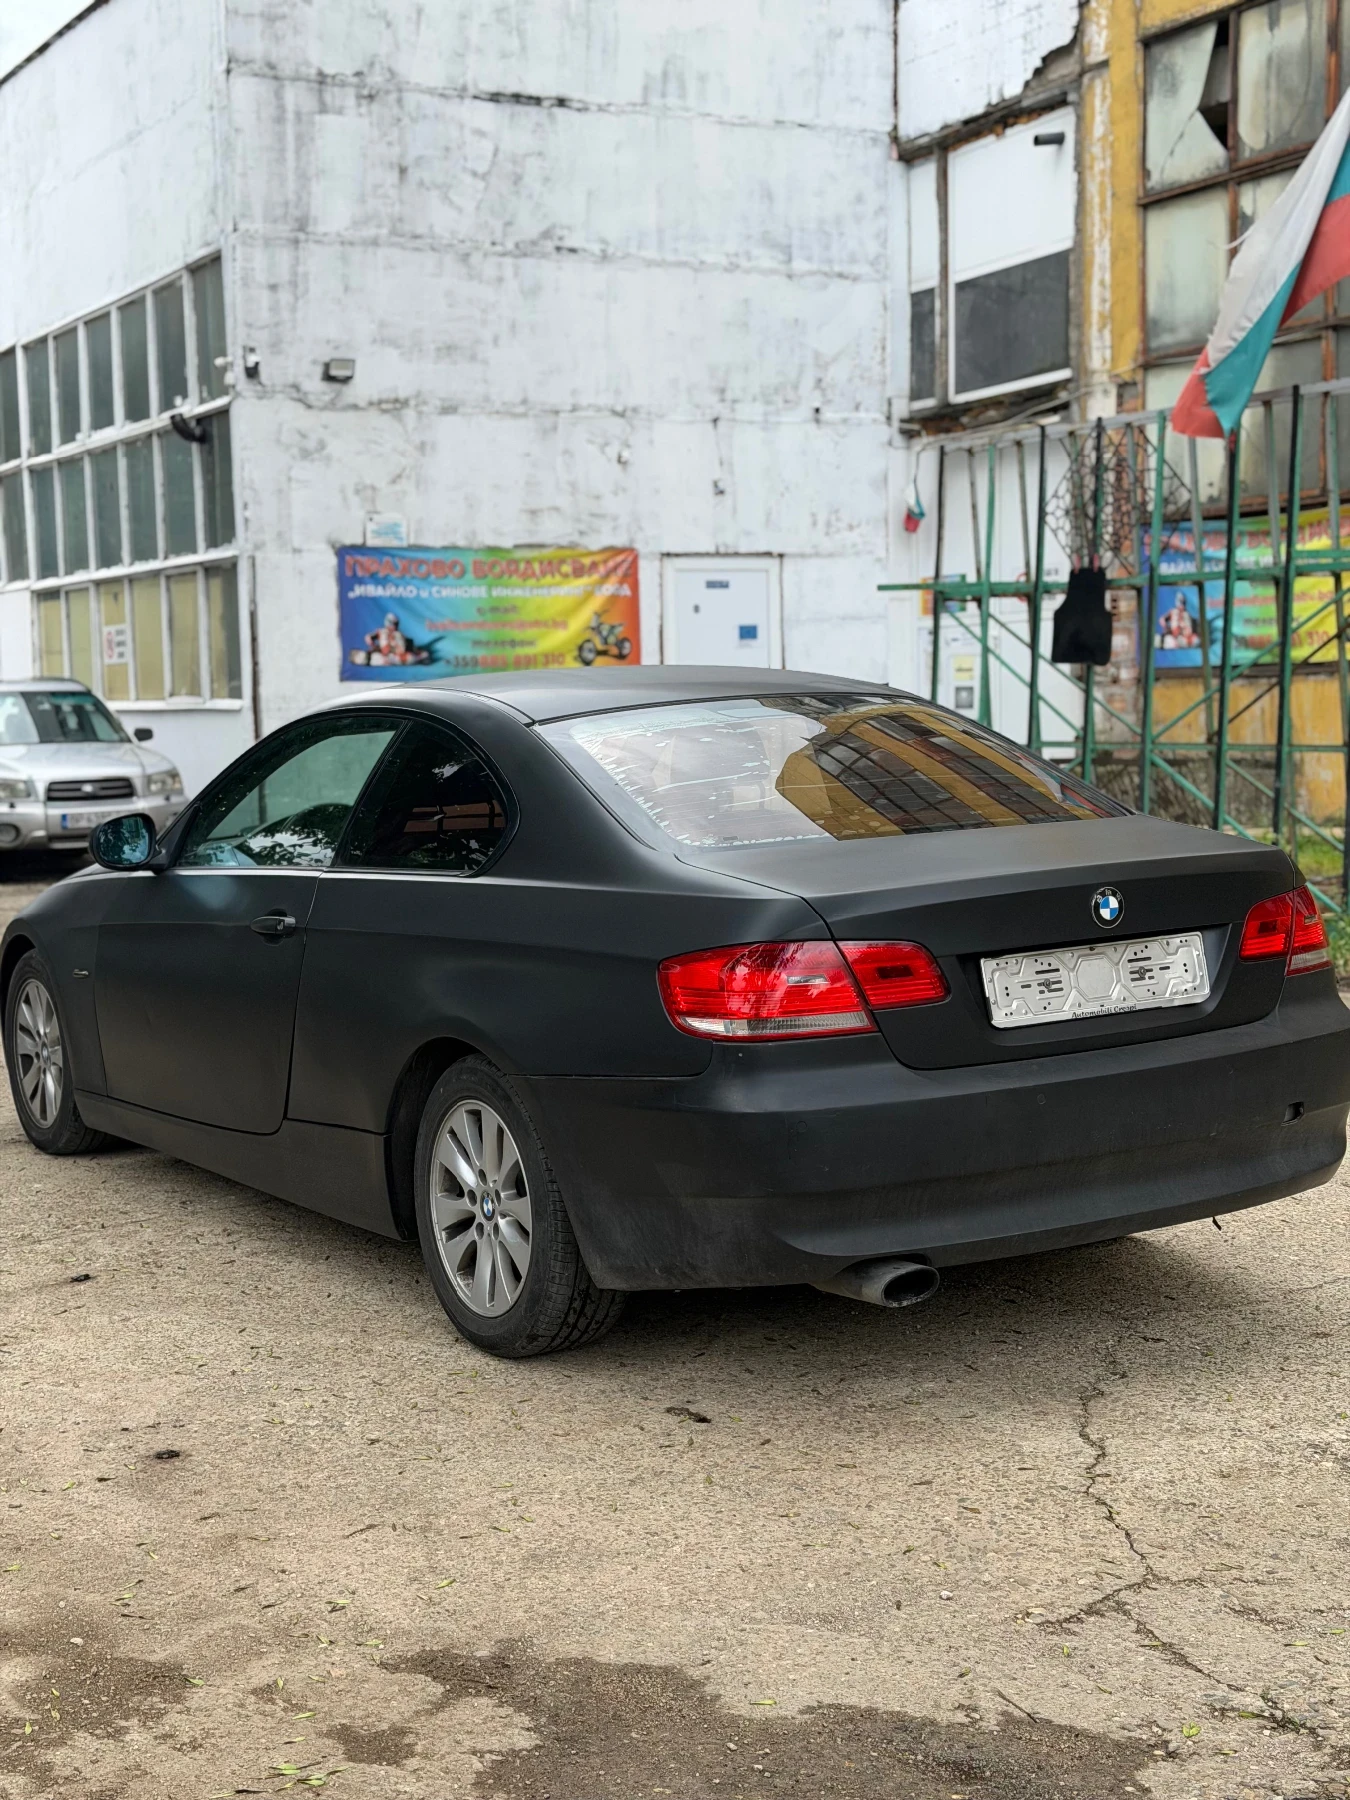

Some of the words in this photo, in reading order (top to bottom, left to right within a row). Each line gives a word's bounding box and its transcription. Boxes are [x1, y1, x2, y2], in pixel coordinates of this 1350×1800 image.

[345, 555, 466, 579] ПРАХОВО
[472, 556, 633, 581] БОЯДИСВАНЕ
[431, 585, 489, 598] СИНОВЕ
[1071, 1006, 1113, 1019] Automobili
